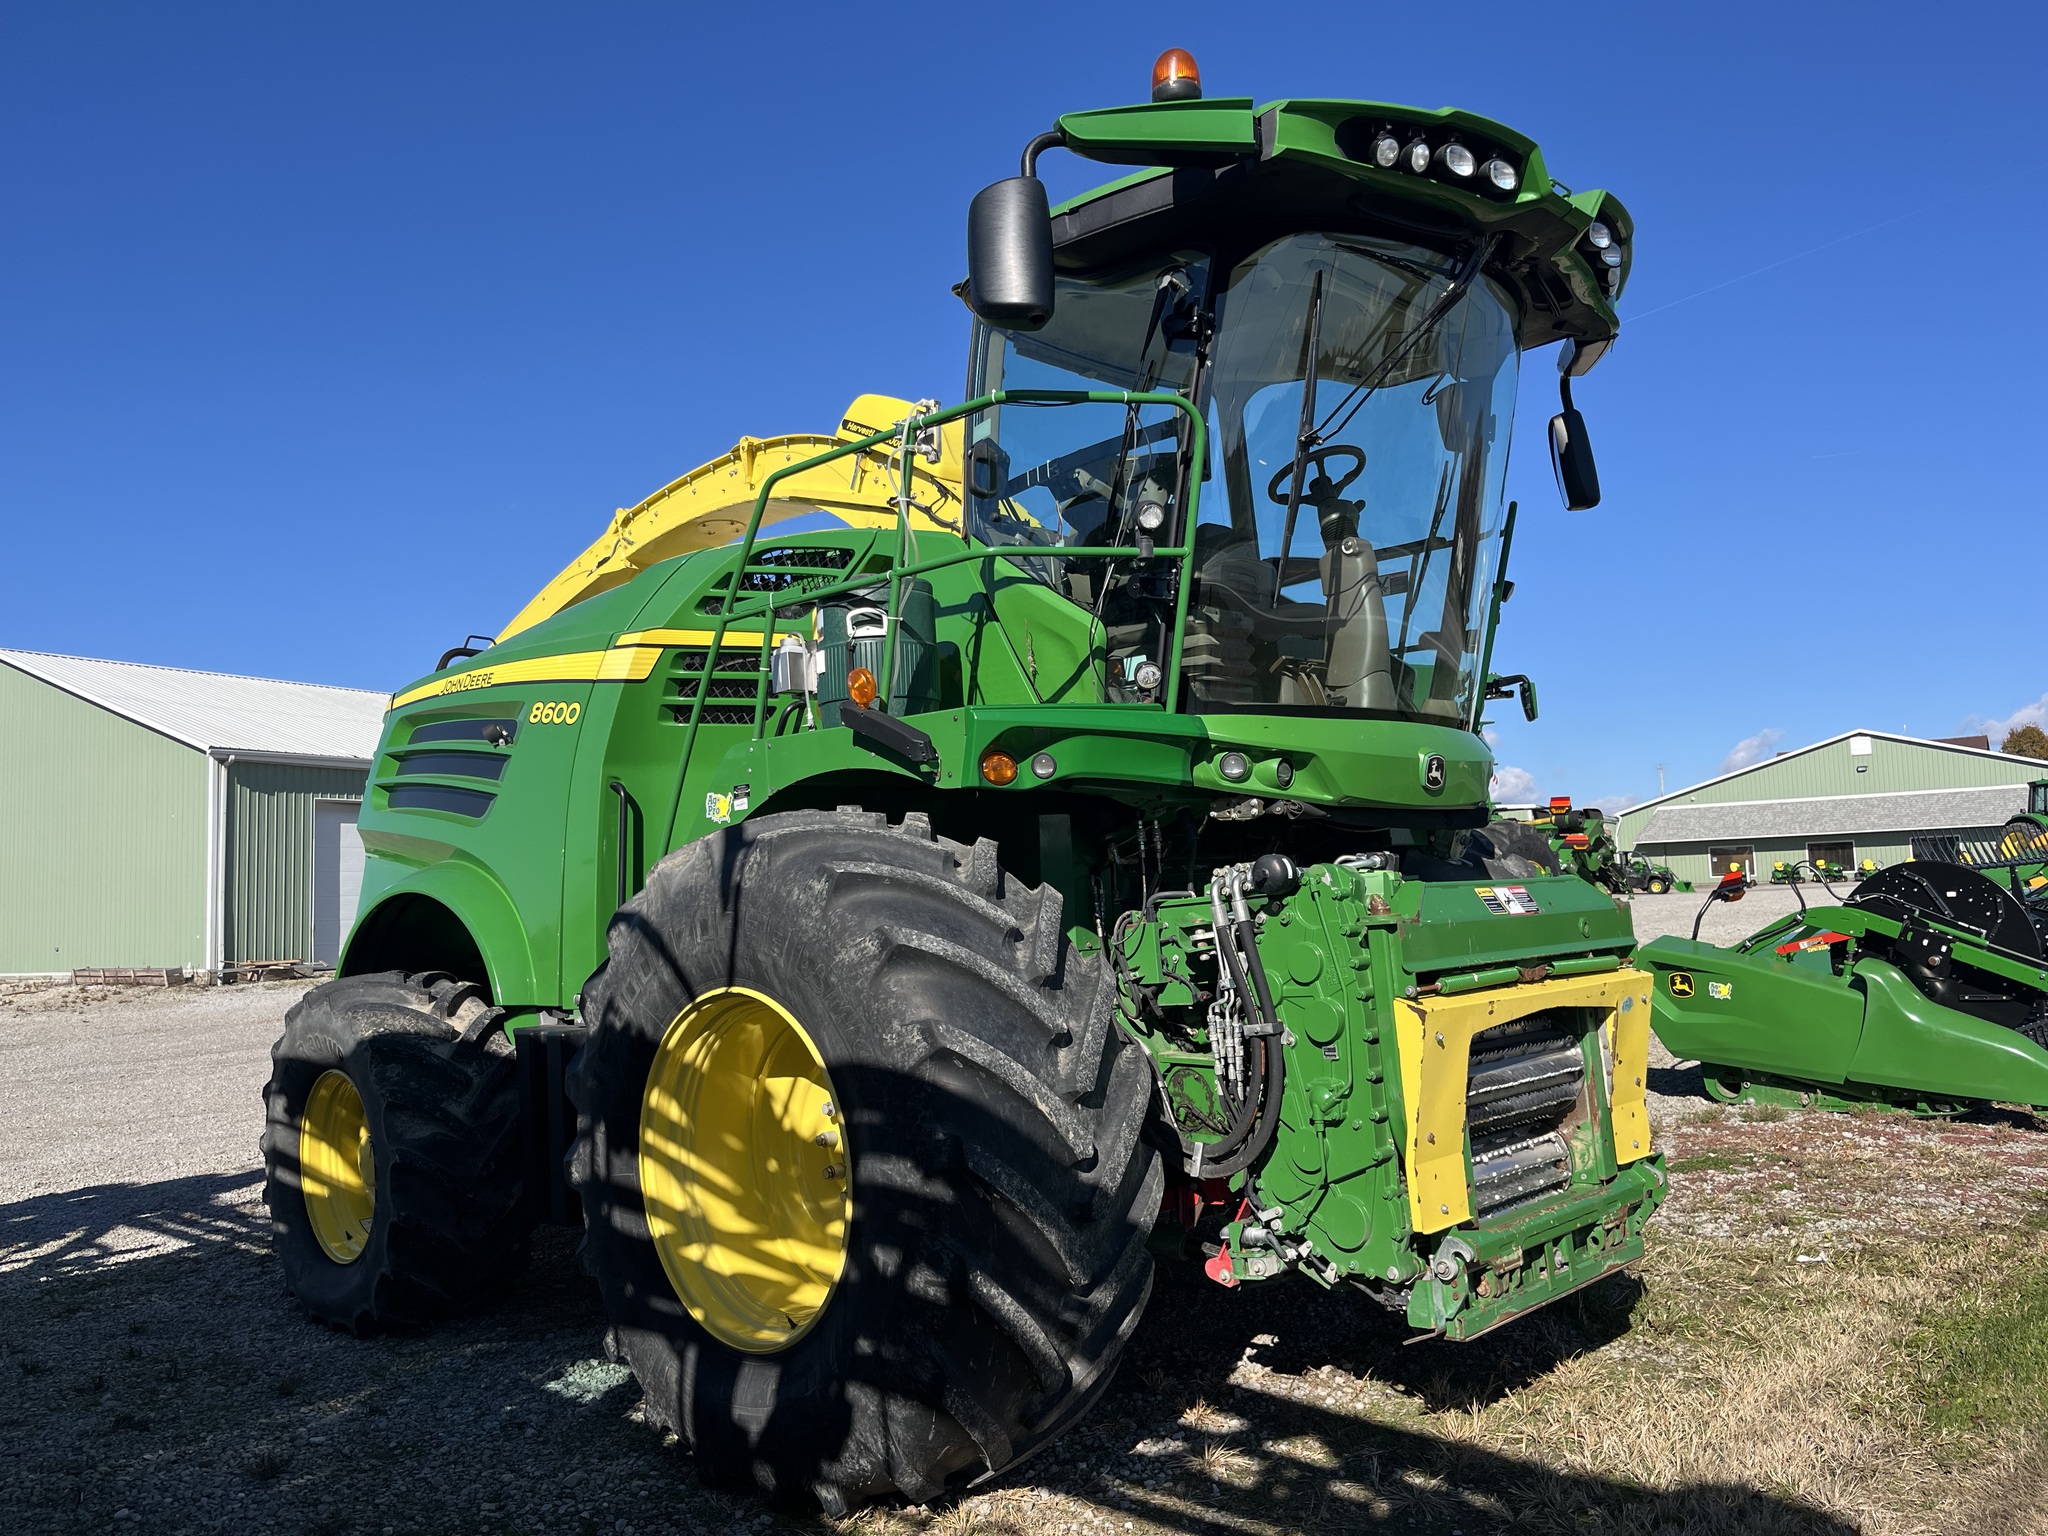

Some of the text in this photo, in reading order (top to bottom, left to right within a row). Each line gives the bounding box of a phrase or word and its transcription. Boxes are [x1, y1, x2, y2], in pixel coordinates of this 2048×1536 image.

[440, 672, 495, 694] JOHN DEERE
[529, 700, 581, 726] 8600
[708, 805, 720, 815] Pro
